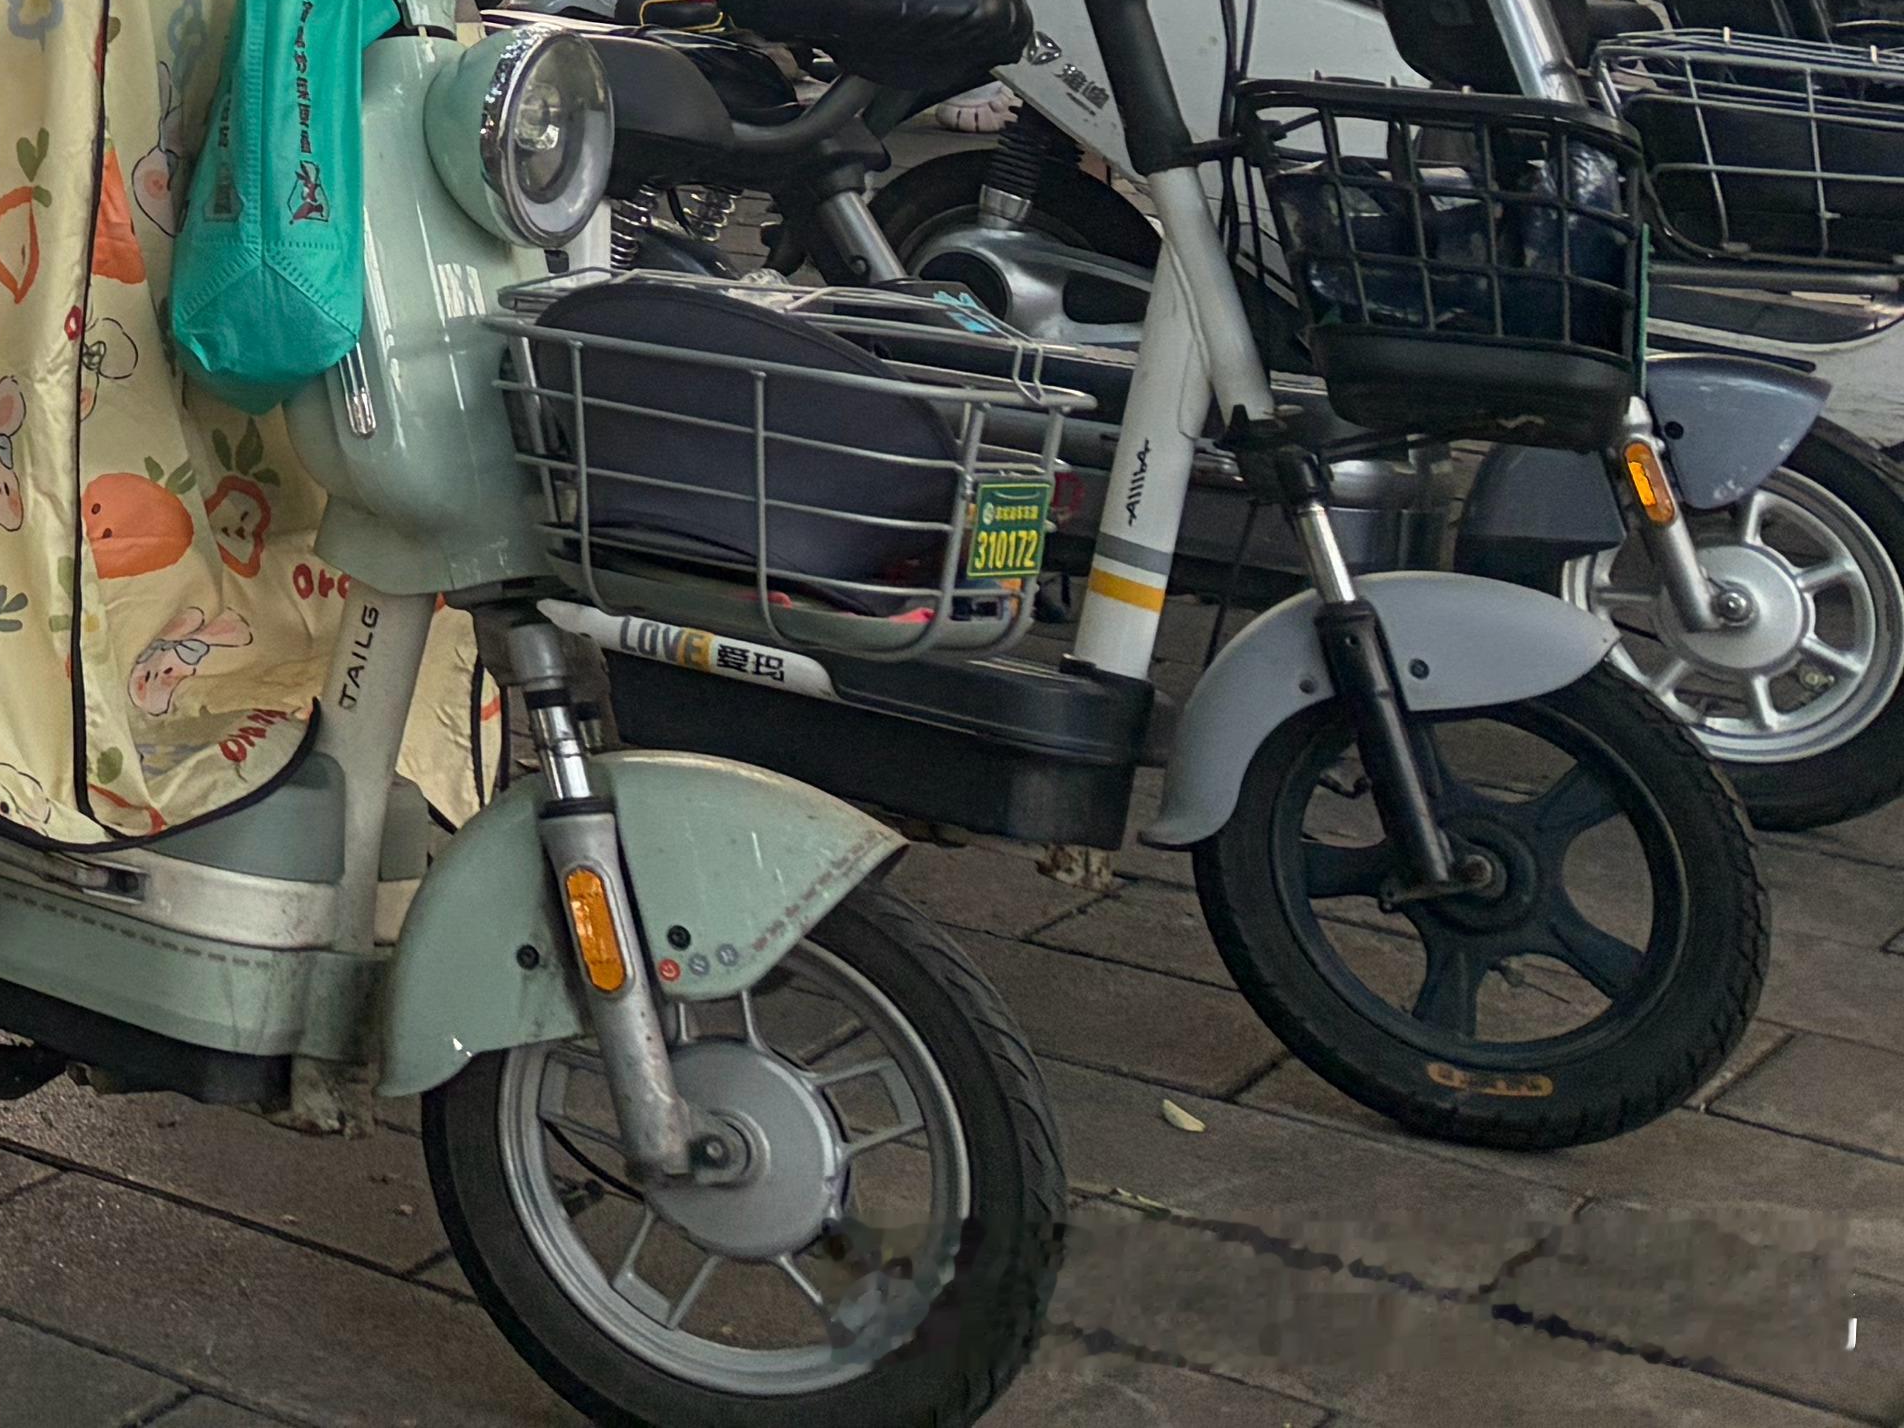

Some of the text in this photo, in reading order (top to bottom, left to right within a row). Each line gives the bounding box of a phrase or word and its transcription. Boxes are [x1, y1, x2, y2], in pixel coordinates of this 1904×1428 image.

[975, 529, 1039, 569] 310172
[339, 605, 380, 710] TAILG
[620, 615, 706, 667] LOVE
